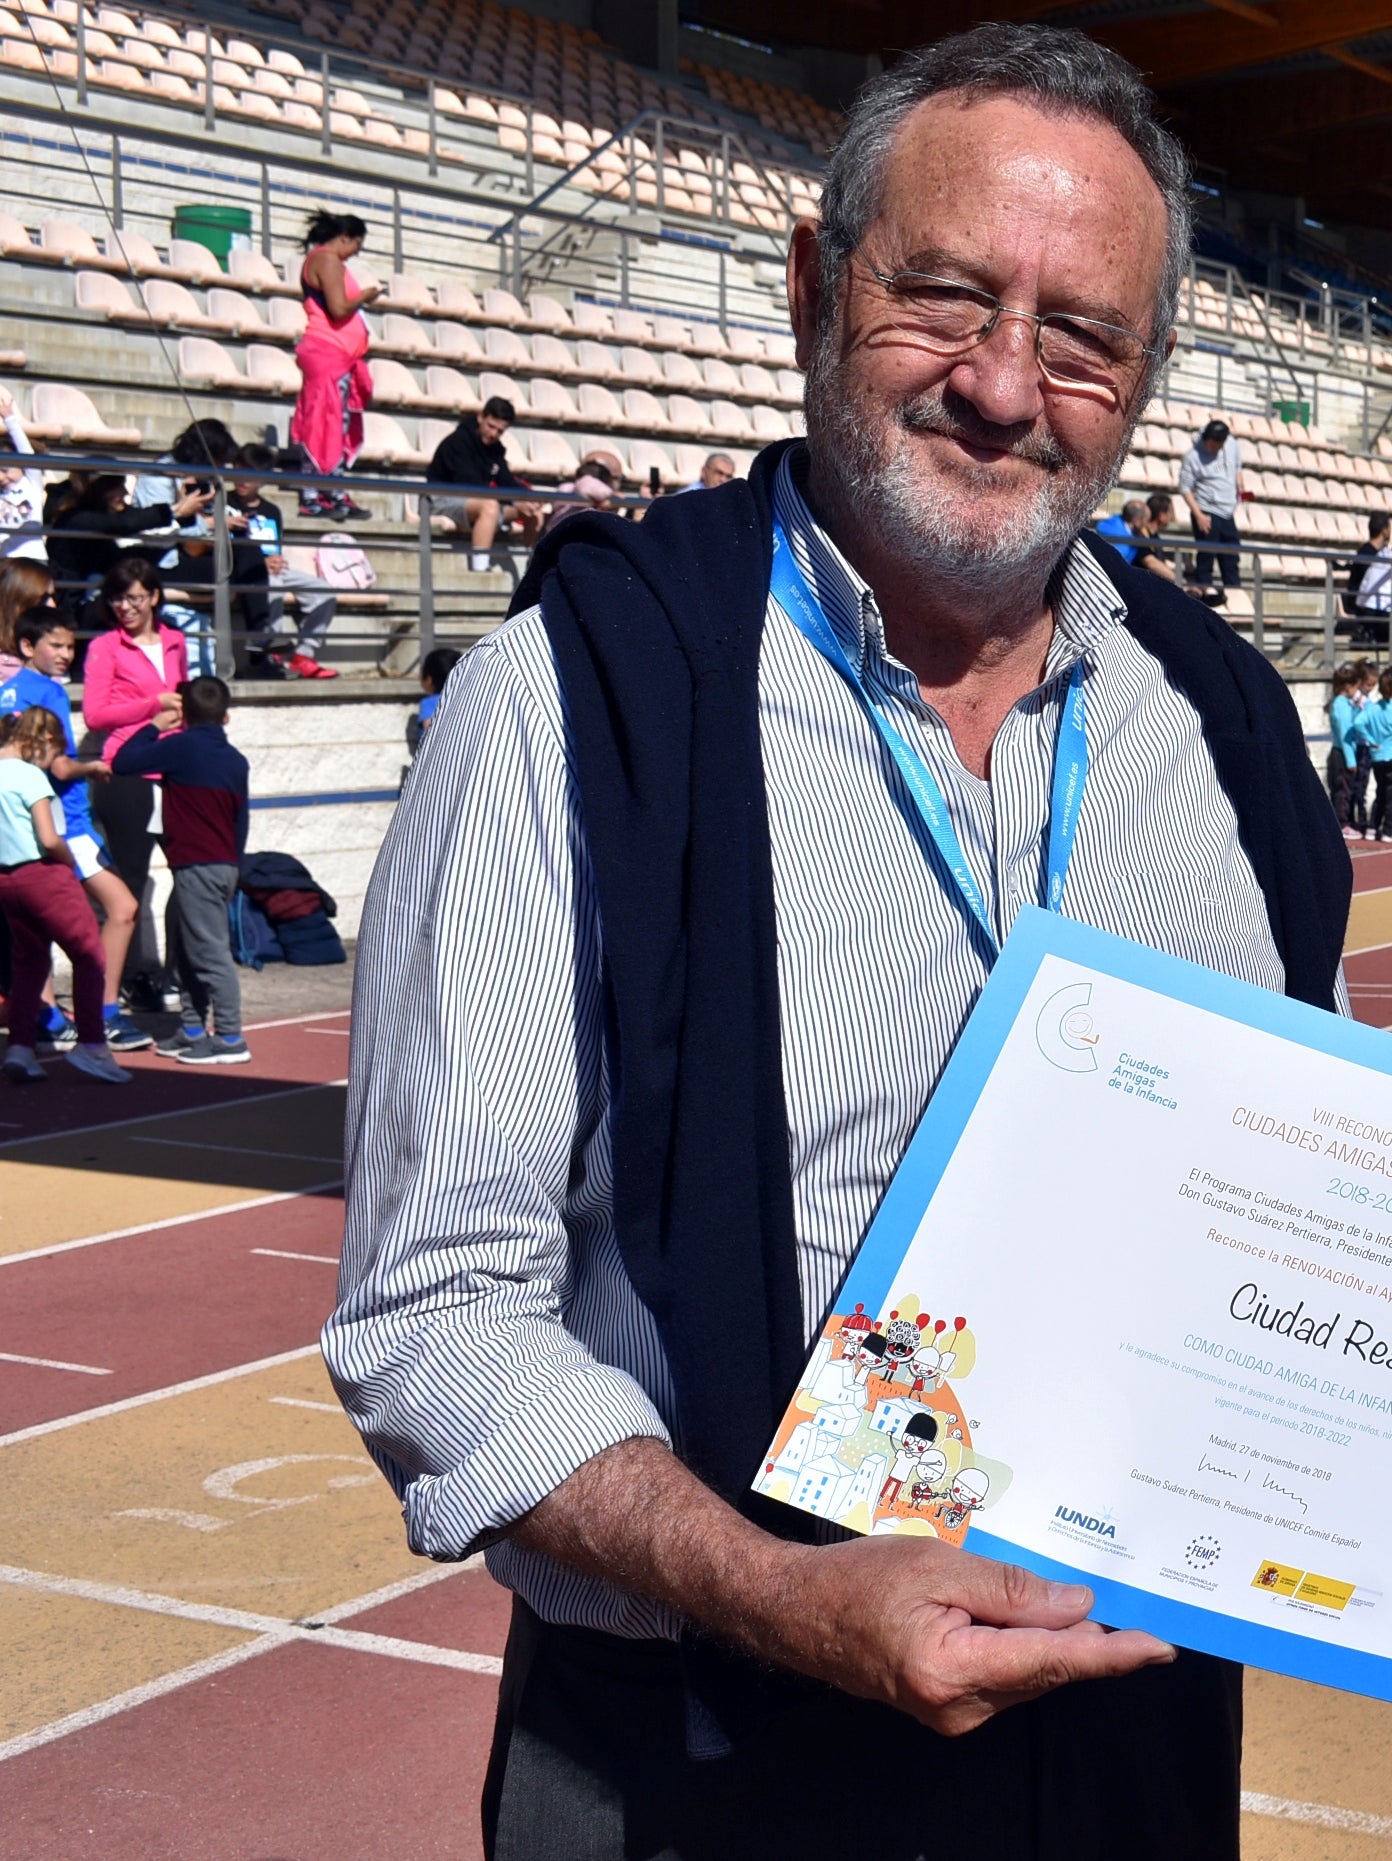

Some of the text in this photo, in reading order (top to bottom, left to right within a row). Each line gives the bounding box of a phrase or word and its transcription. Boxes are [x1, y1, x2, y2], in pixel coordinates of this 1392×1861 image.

[898, 746, 940, 827] www.unicef.es
[1061, 762, 1079, 837] www.unicef.es
[1108, 1077, 1178, 1110] de la Infancia
[1112, 1065, 1156, 1092] Amigas
[1119, 1053, 1170, 1079] Ciudades
[1232, 1107, 1323, 1152] CIUDADES
[1313, 1107, 1334, 1127] VIII
[1178, 1183, 1200, 1200] Don
[1203, 1192, 1245, 1217] Gustavo
[1247, 1208, 1284, 1231] Suárez
[1285, 1221, 1332, 1249] Pertierra,
[1336, 1238, 1392, 1266] Presidente
[1189, 1168, 1201, 1181] El
[1201, 1172, 1252, 1200] Programa
[1254, 1192, 1303, 1218] Ciudades
[1304, 1210, 1345, 1232] Amigas
[1346, 1224, 1360, 1237] de
[1362, 1228, 1373, 1241] la
[1206, 1228, 1266, 1258] Reconoce
[1268, 1250, 1279, 1263] la
[1282, 1255, 1364, 1291] RENOVACIÓN
[1365, 1284, 1378, 1295] al
[1229, 1282, 1341, 1350] Ciudad
[1125, 1342, 1134, 1352] le
[1134, 1347, 1170, 1366] agradece
[1170, 1361, 1180, 1370] su
[1181, 1365, 1227, 1387] compromiso
[1227, 1381, 1238, 1390] en
[1238, 1385, 1248, 1393] el
[1247, 1389, 1275, 1403] avance
[1273, 1396, 1286, 1406] de
[1286, 1400, 1299, 1411] los
[1299, 1404, 1334, 1422] derechos
[1334, 1416, 1345, 1425] de
[1345, 1418, 1357, 1429] los
[1358, 1423, 1380, 1438] niños,
[1184, 1334, 1223, 1358] COMO
[1225, 1349, 1274, 1375] CIUDAD
[1274, 1366, 1317, 1391] AMIGA
[1320, 1380, 1339, 1397] DE
[1339, 1386, 1355, 1403] LA
[1215, 1397, 1243, 1412] vigente
[1242, 1407, 1260, 1418] para
[1261, 1412, 1270, 1421] el
[1299, 1421, 1352, 1447] 2018-2022
[1209, 1434, 1332, 1481] Madrid, 27 de noviembre de 2018
[1054, 1505, 1116, 1539] IUNDIA
[1130, 1469, 1362, 1549] Gustavo Suárez Pertierra, Presidente de UNICEF Comité Español
[1191, 1545, 1215, 1560] FEMP
